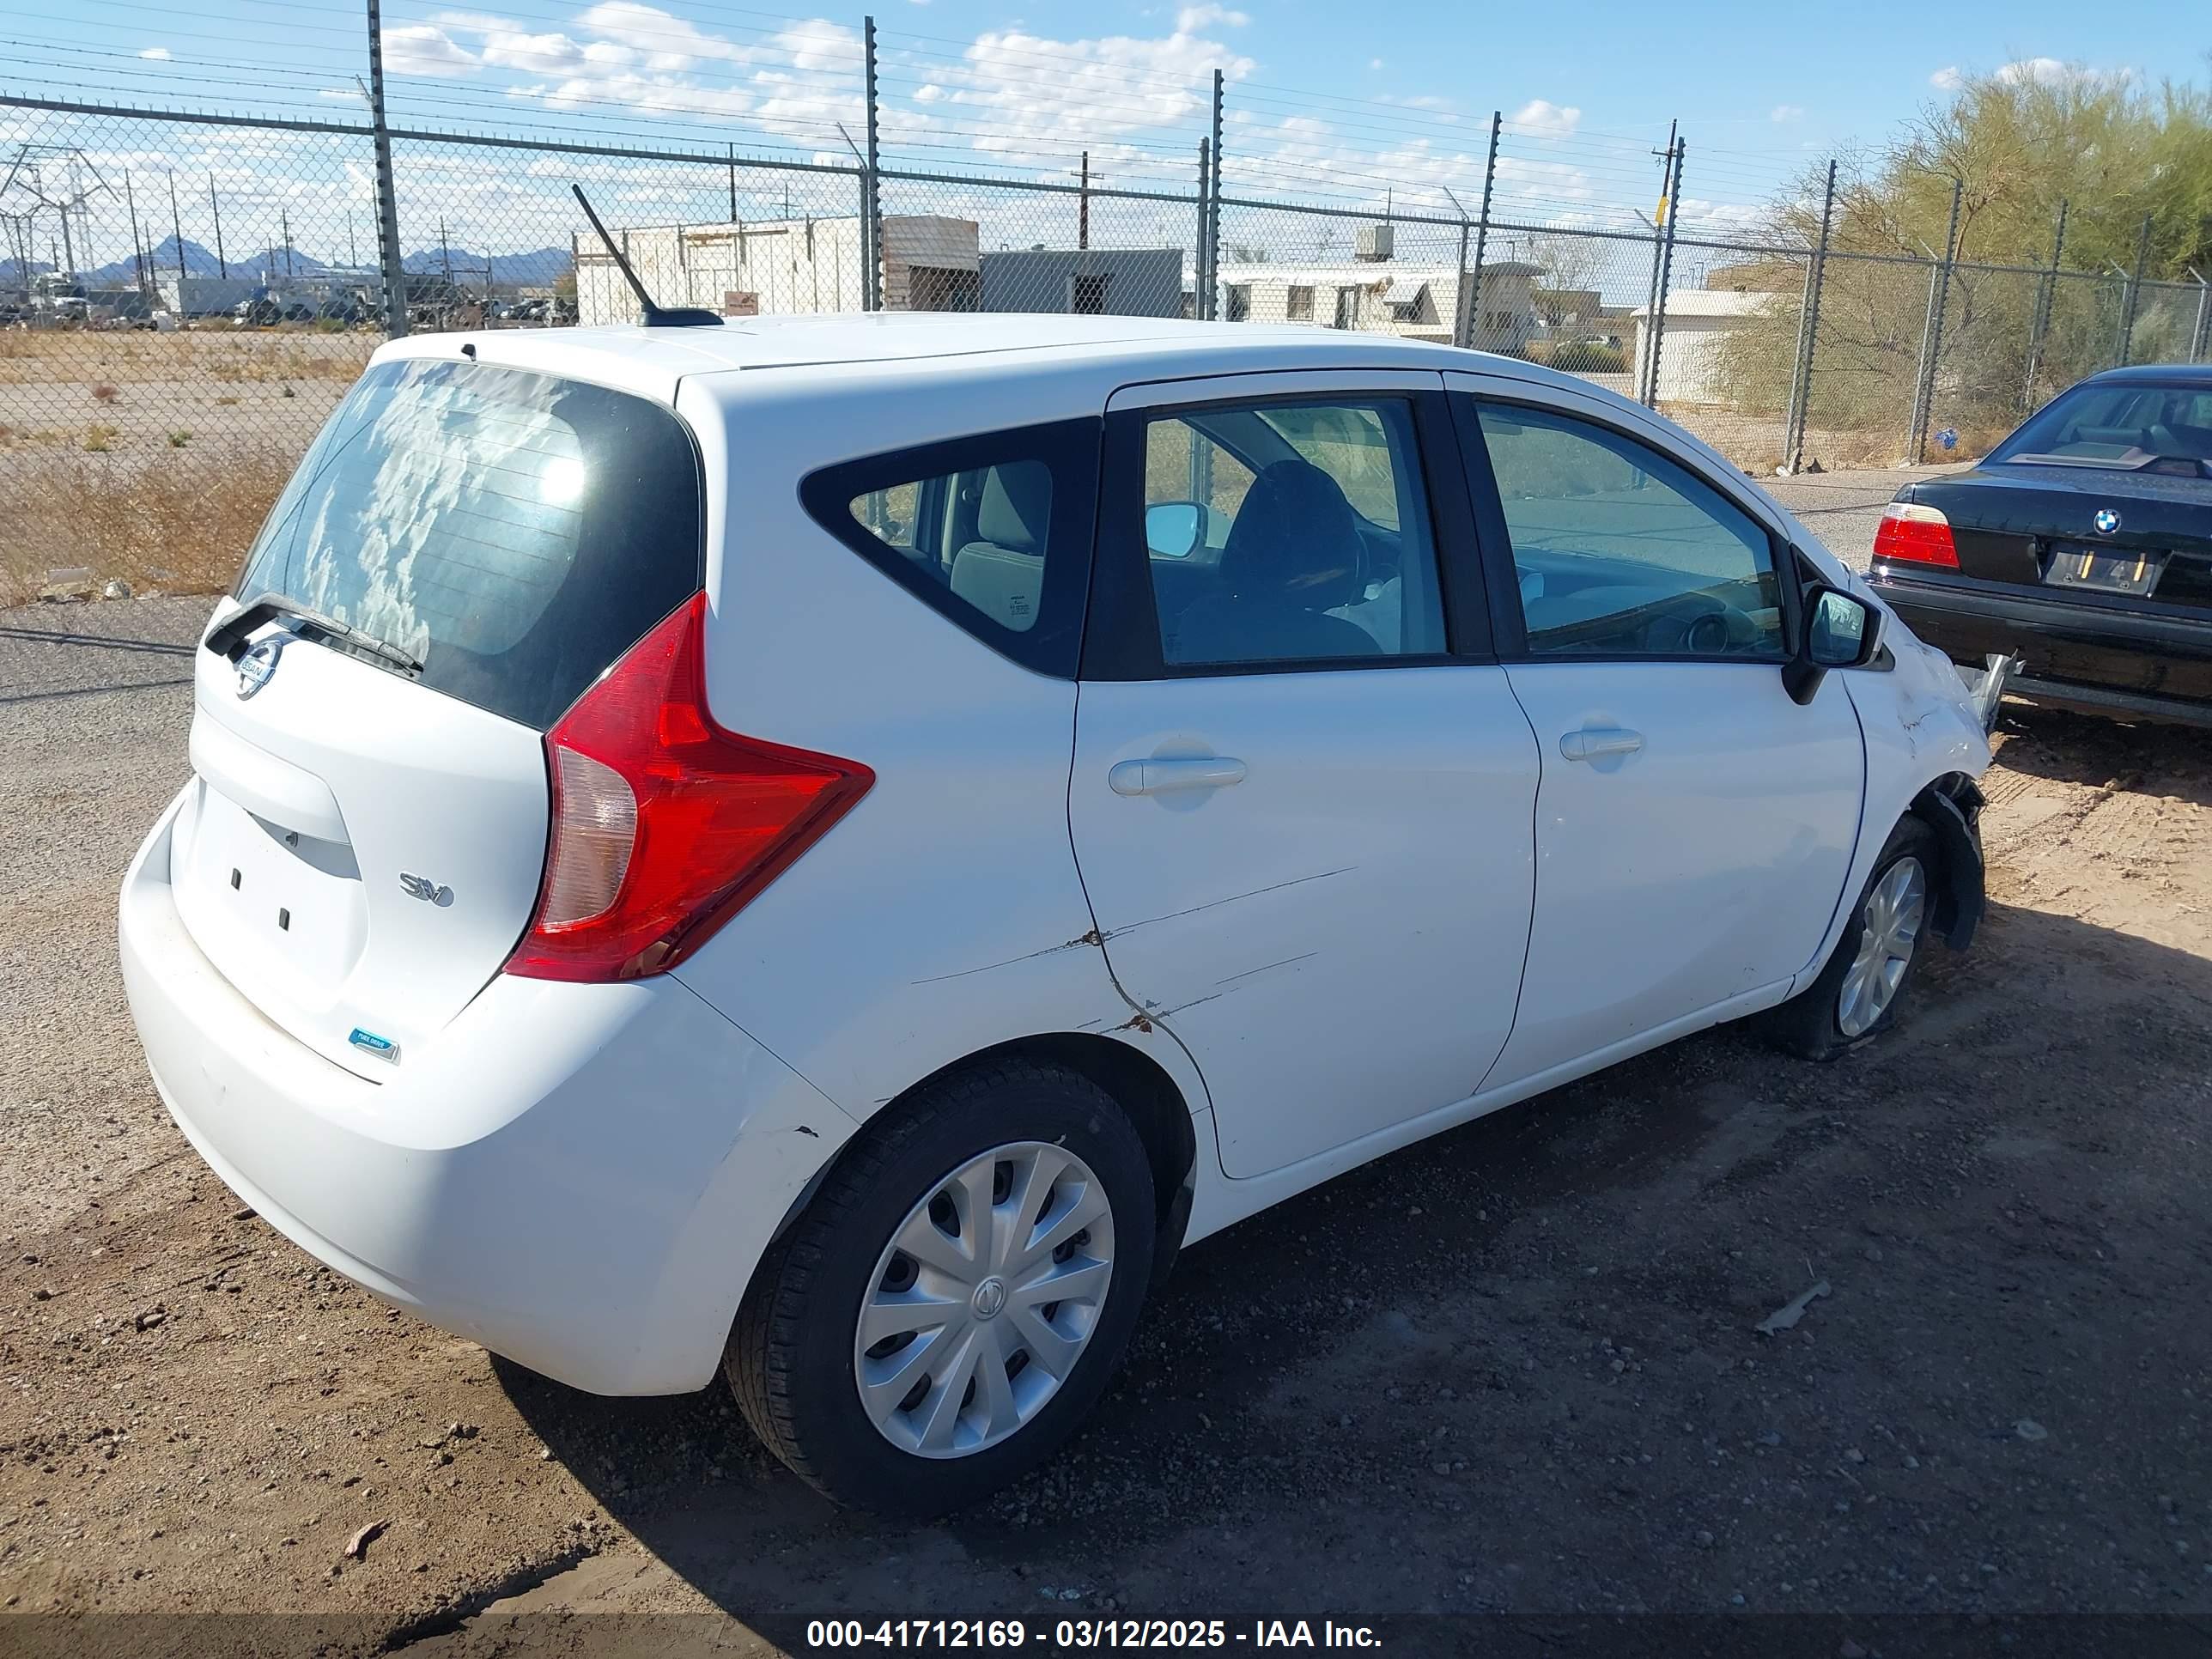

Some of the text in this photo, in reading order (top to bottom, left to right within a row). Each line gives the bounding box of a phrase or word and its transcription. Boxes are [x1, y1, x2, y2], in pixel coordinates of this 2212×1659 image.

[399, 872, 455, 908] SV
[357, 1033, 386, 1048] PURE DRIVE
